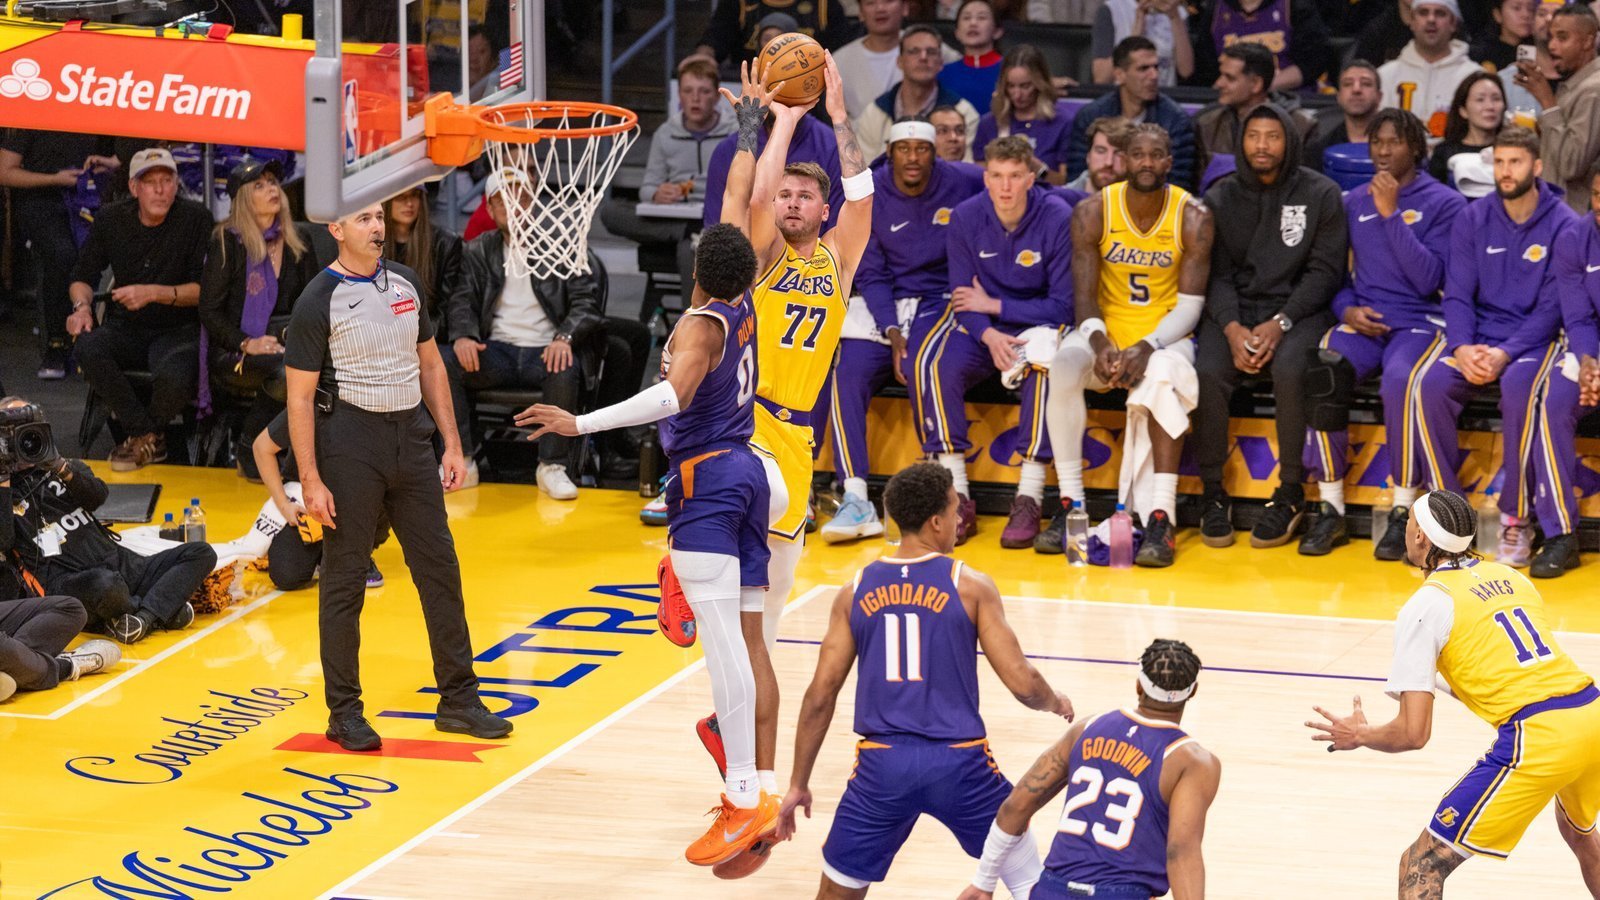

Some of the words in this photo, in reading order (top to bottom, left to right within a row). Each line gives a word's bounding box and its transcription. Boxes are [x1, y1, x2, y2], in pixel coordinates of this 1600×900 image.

[56, 63, 154, 110] State
[155, 73, 251, 120] Farm
[1104, 241, 1173, 268] LAKERS
[392, 302, 415, 313] Emirates
[1129, 272, 1150, 304] 5
[780, 302, 827, 351] 77
[737, 344, 754, 408] 0
[859, 583, 950, 617] IGHODARO
[1469, 579, 1514, 601] HAYES
[883, 612, 923, 682] 11
[1494, 606, 1555, 667] 11
[65, 687, 309, 785] Courtside
[1082, 737, 1152, 778] GOODWIN
[36, 767, 399, 900] Michelob
[1058, 765, 1144, 851] 23
